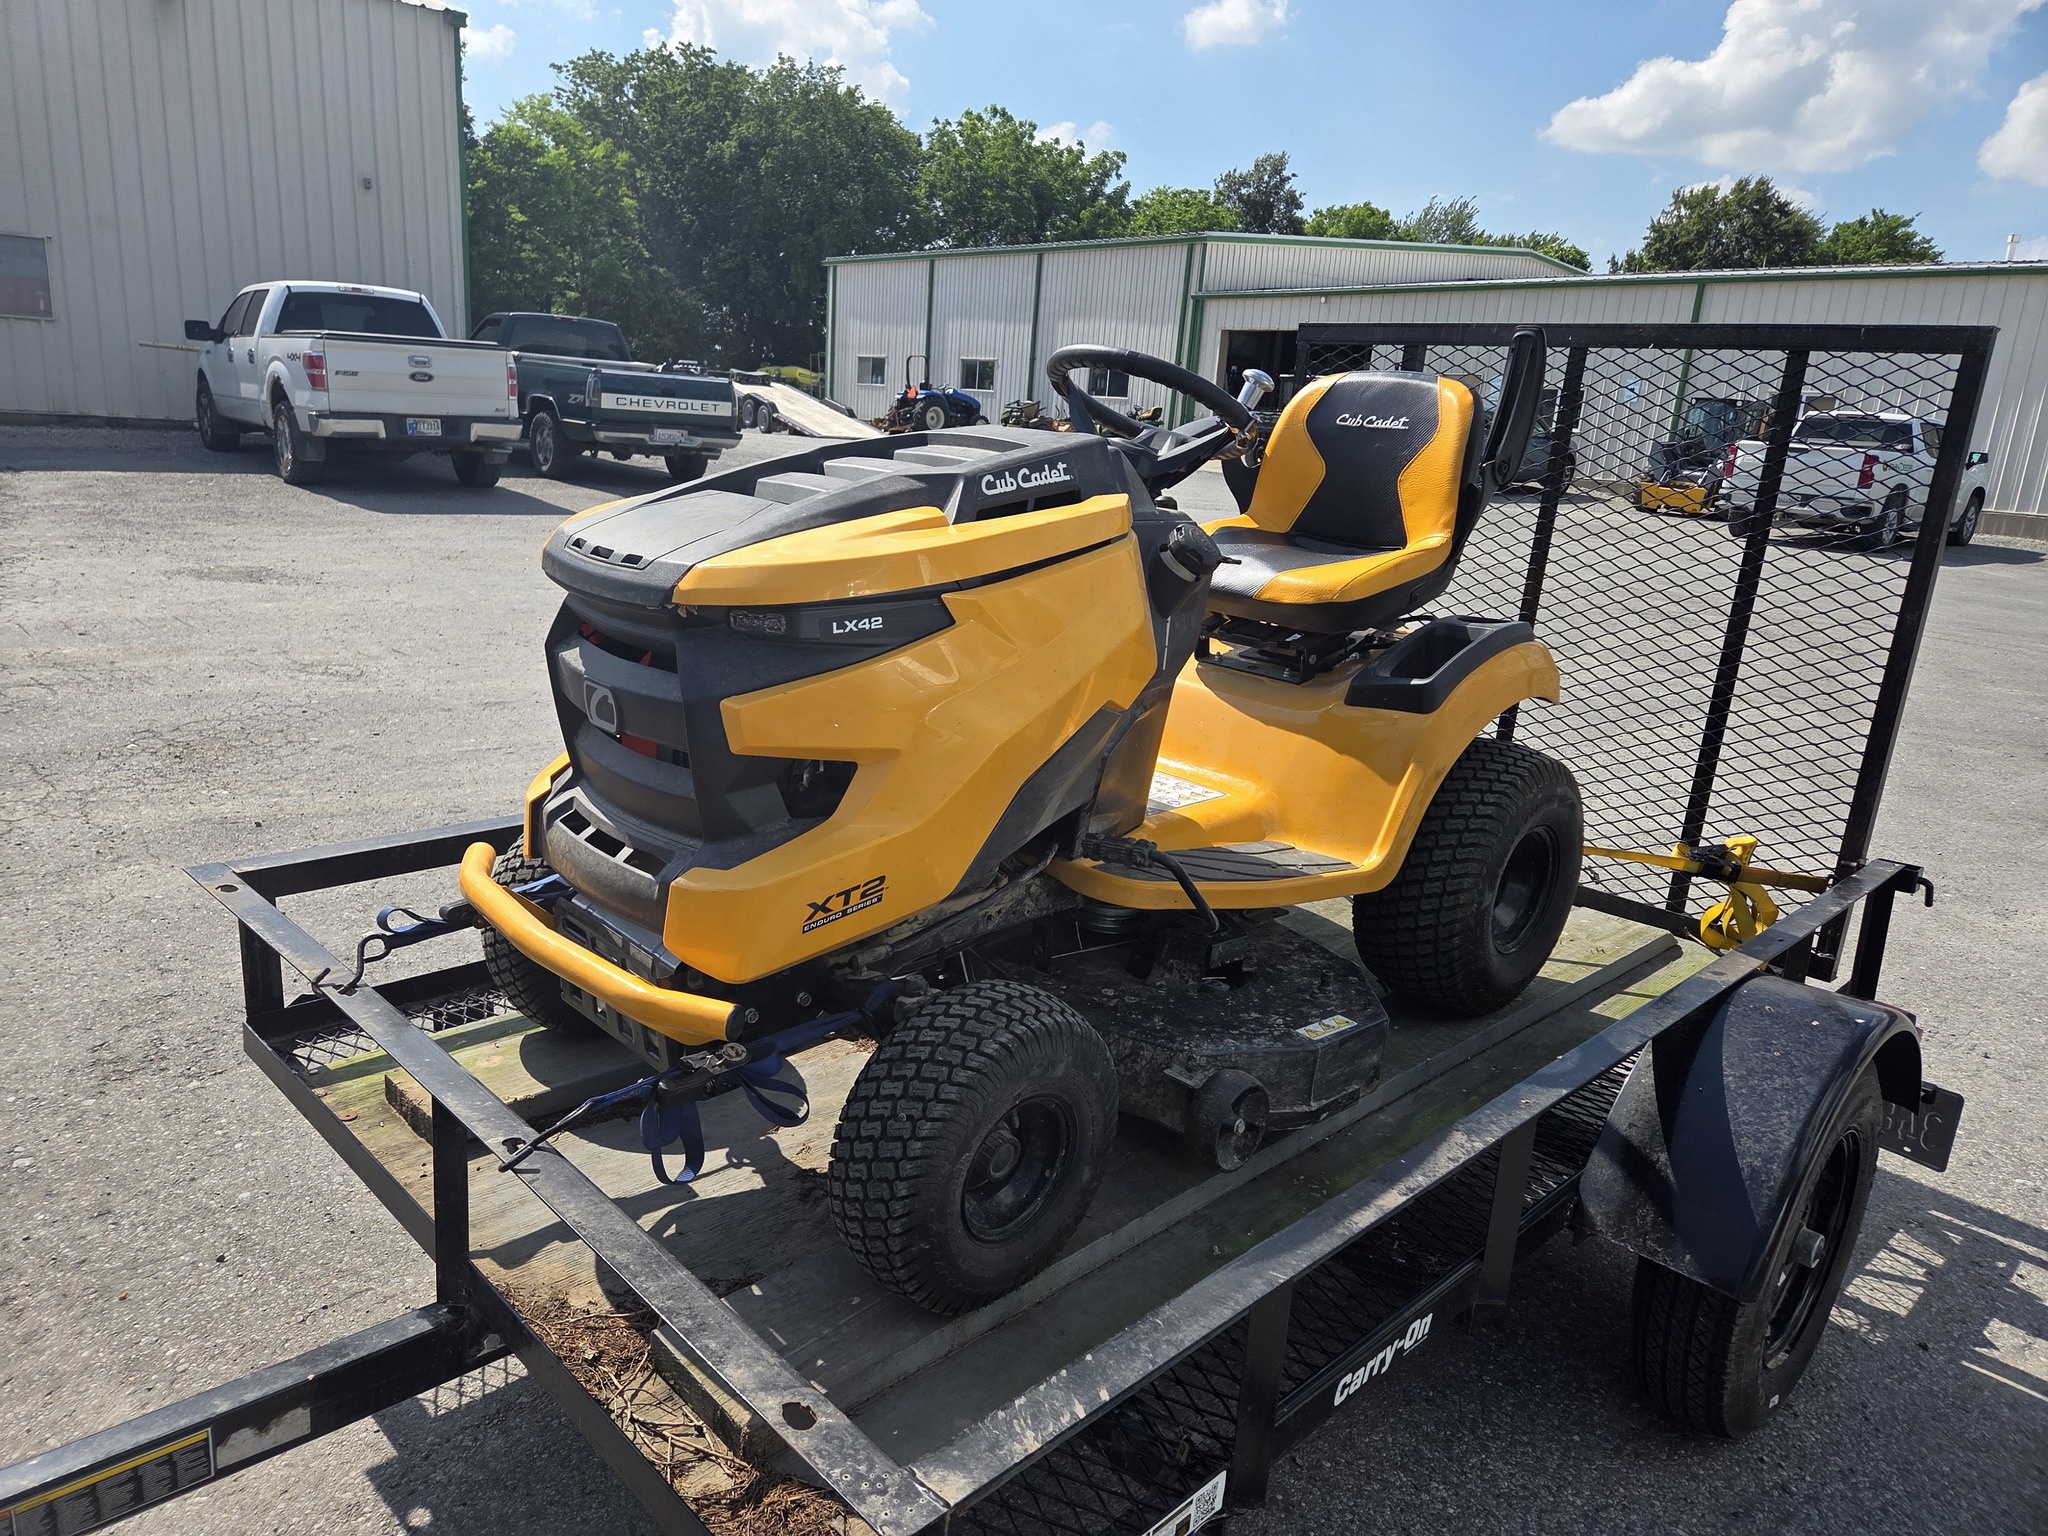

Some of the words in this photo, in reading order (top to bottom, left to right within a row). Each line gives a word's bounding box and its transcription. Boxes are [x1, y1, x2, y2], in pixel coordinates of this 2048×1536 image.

[615, 396, 721, 413] CHEVROLET
[1336, 413, 1363, 427] Cub
[1363, 415, 1410, 430] Cadet
[981, 471, 1017, 496] Cub
[1017, 461, 1071, 489] Cadet
[831, 616, 883, 635] LX42
[803, 874, 887, 924] XT2
[803, 912, 843, 932] ENDURO
[846, 897, 878, 914] SERIES
[1333, 1312, 1434, 1407] Carry-On
